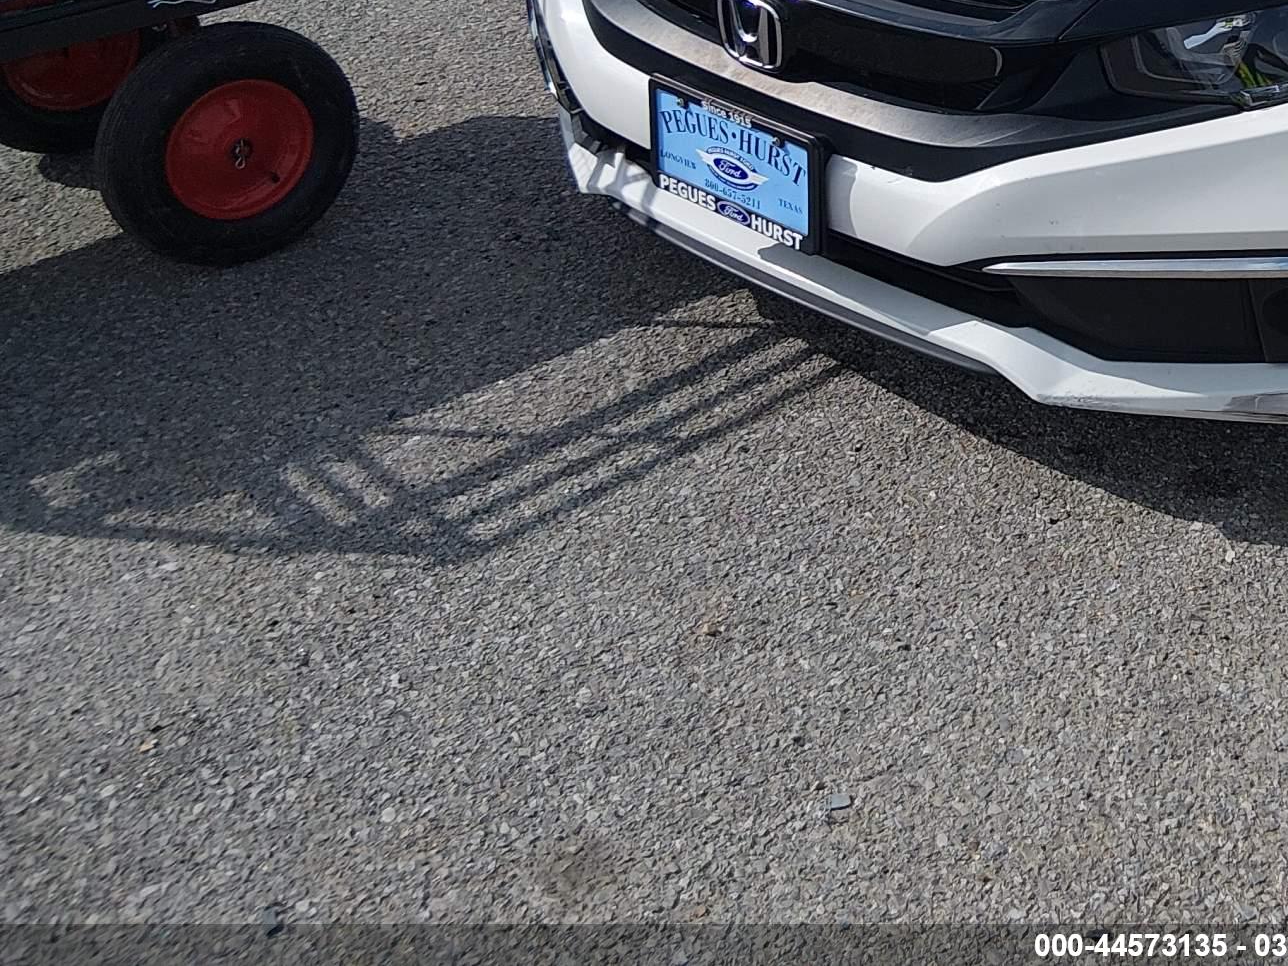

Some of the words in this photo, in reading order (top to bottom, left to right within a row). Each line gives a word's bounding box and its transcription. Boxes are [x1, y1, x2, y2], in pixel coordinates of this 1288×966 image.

[659, 174, 716, 211] PEGUES
[751, 214, 803, 250] HURST
[778, 198, 802, 215] TEXAS
